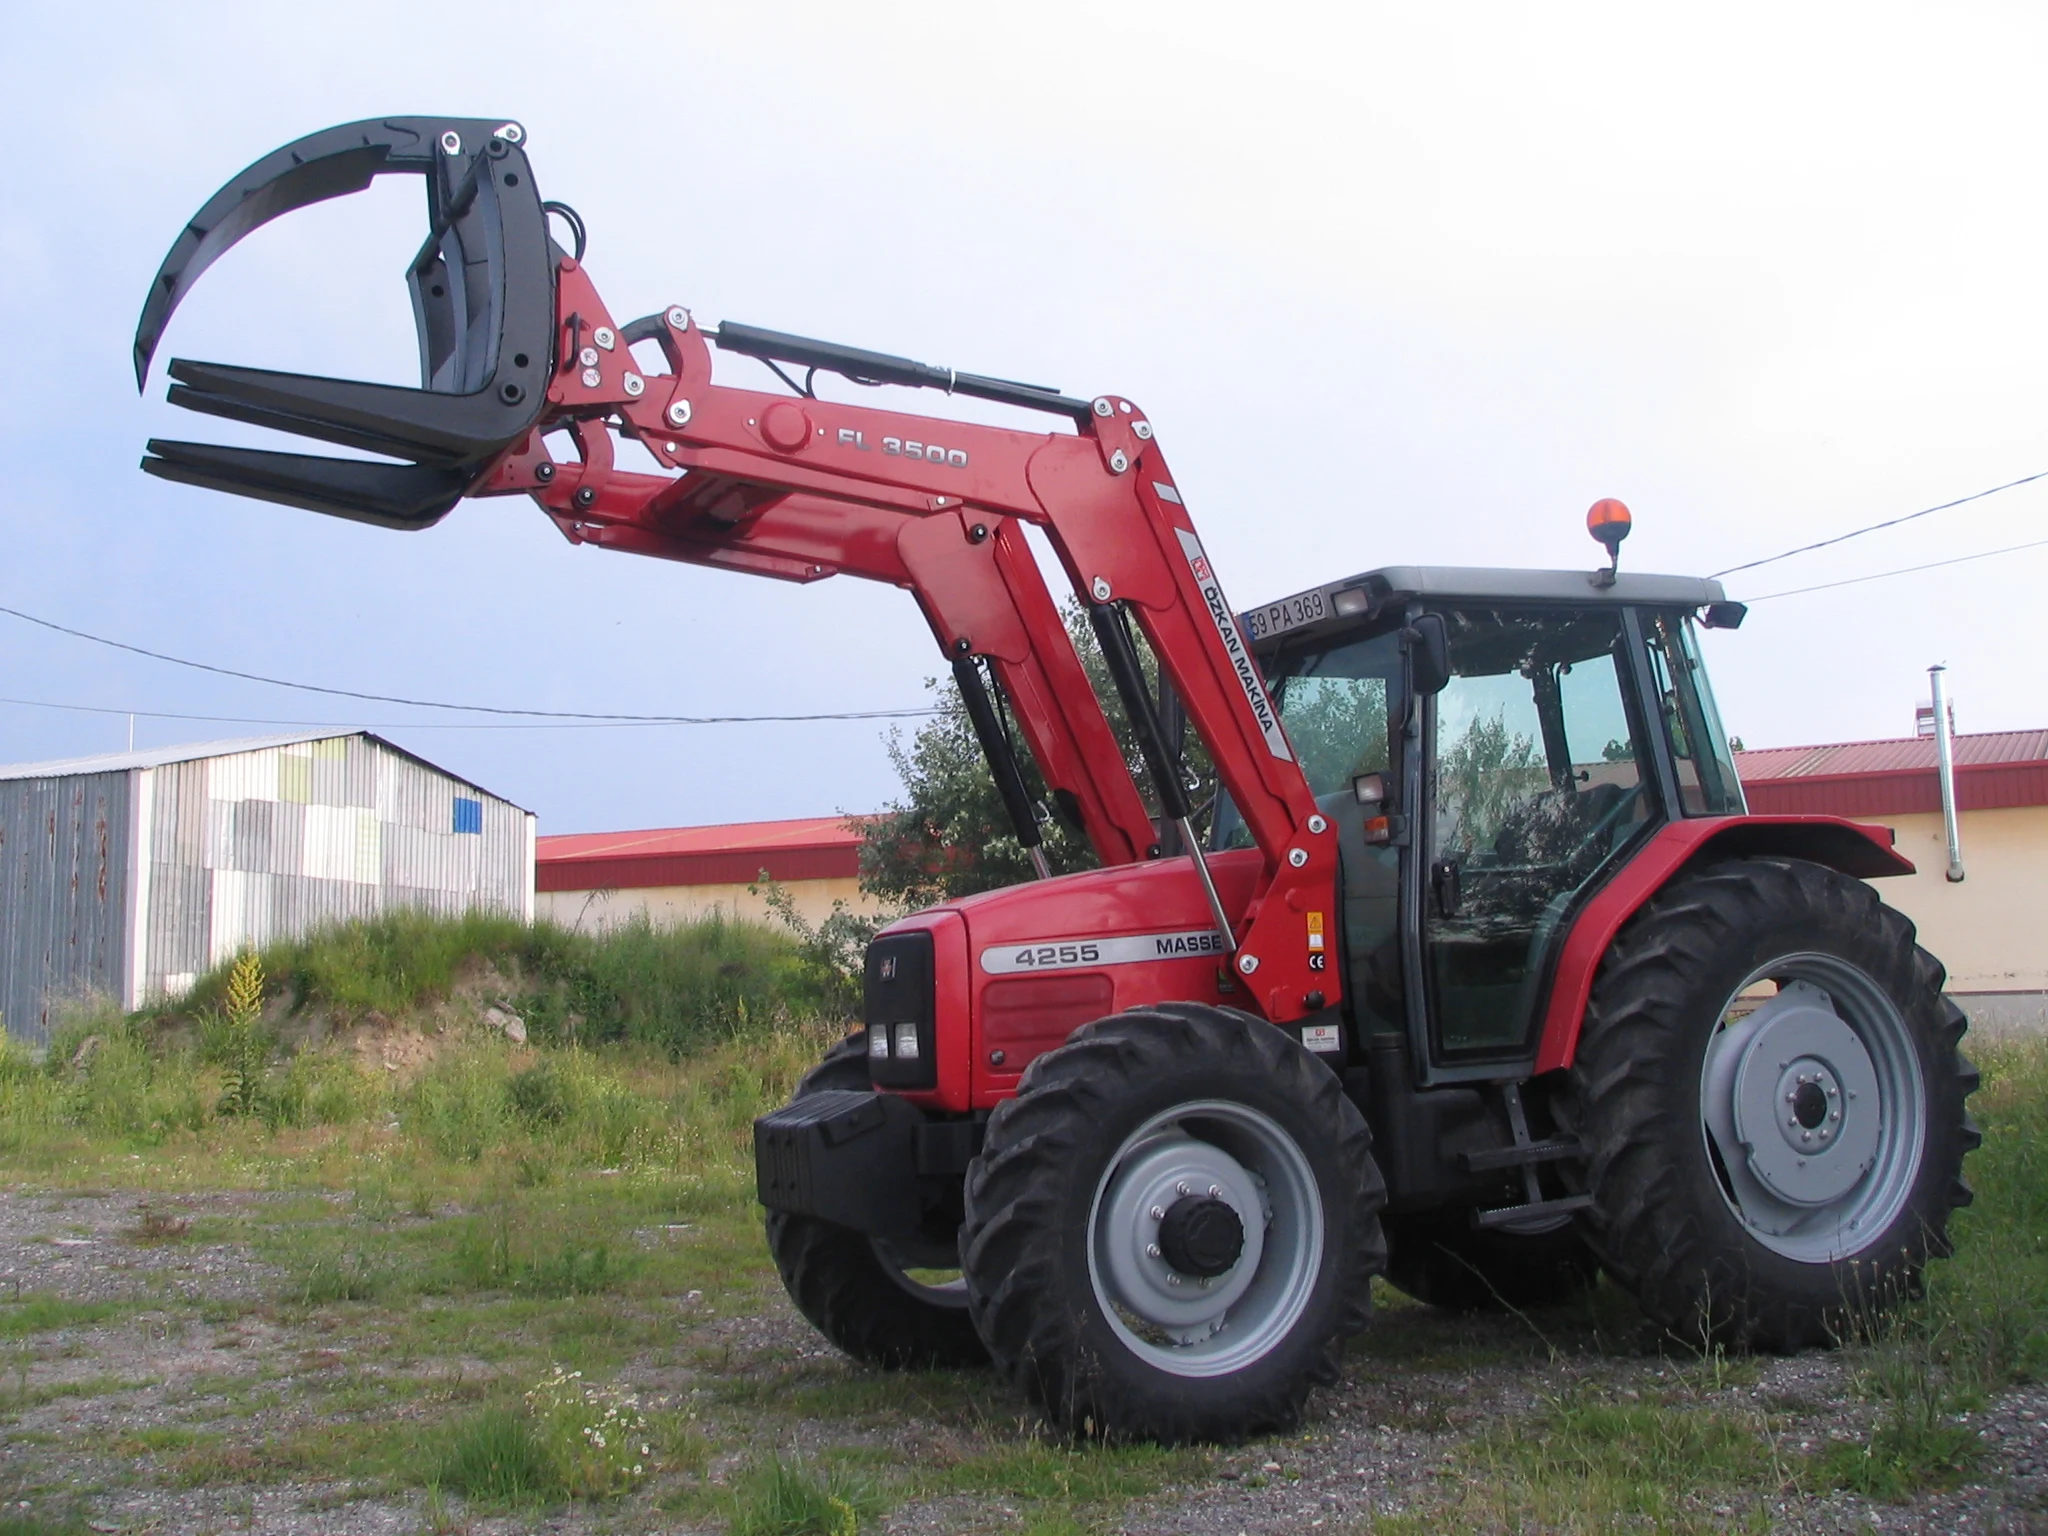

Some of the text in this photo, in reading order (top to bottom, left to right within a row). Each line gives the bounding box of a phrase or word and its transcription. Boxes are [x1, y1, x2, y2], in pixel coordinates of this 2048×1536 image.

[837, 427, 968, 469] FL 3500
[1203, 585, 1240, 654] ÖZKAN
[1249, 593, 1324, 637] 59 PA 369
[1015, 943, 1100, 967] 4255
[1308, 953, 1325, 970] CE
